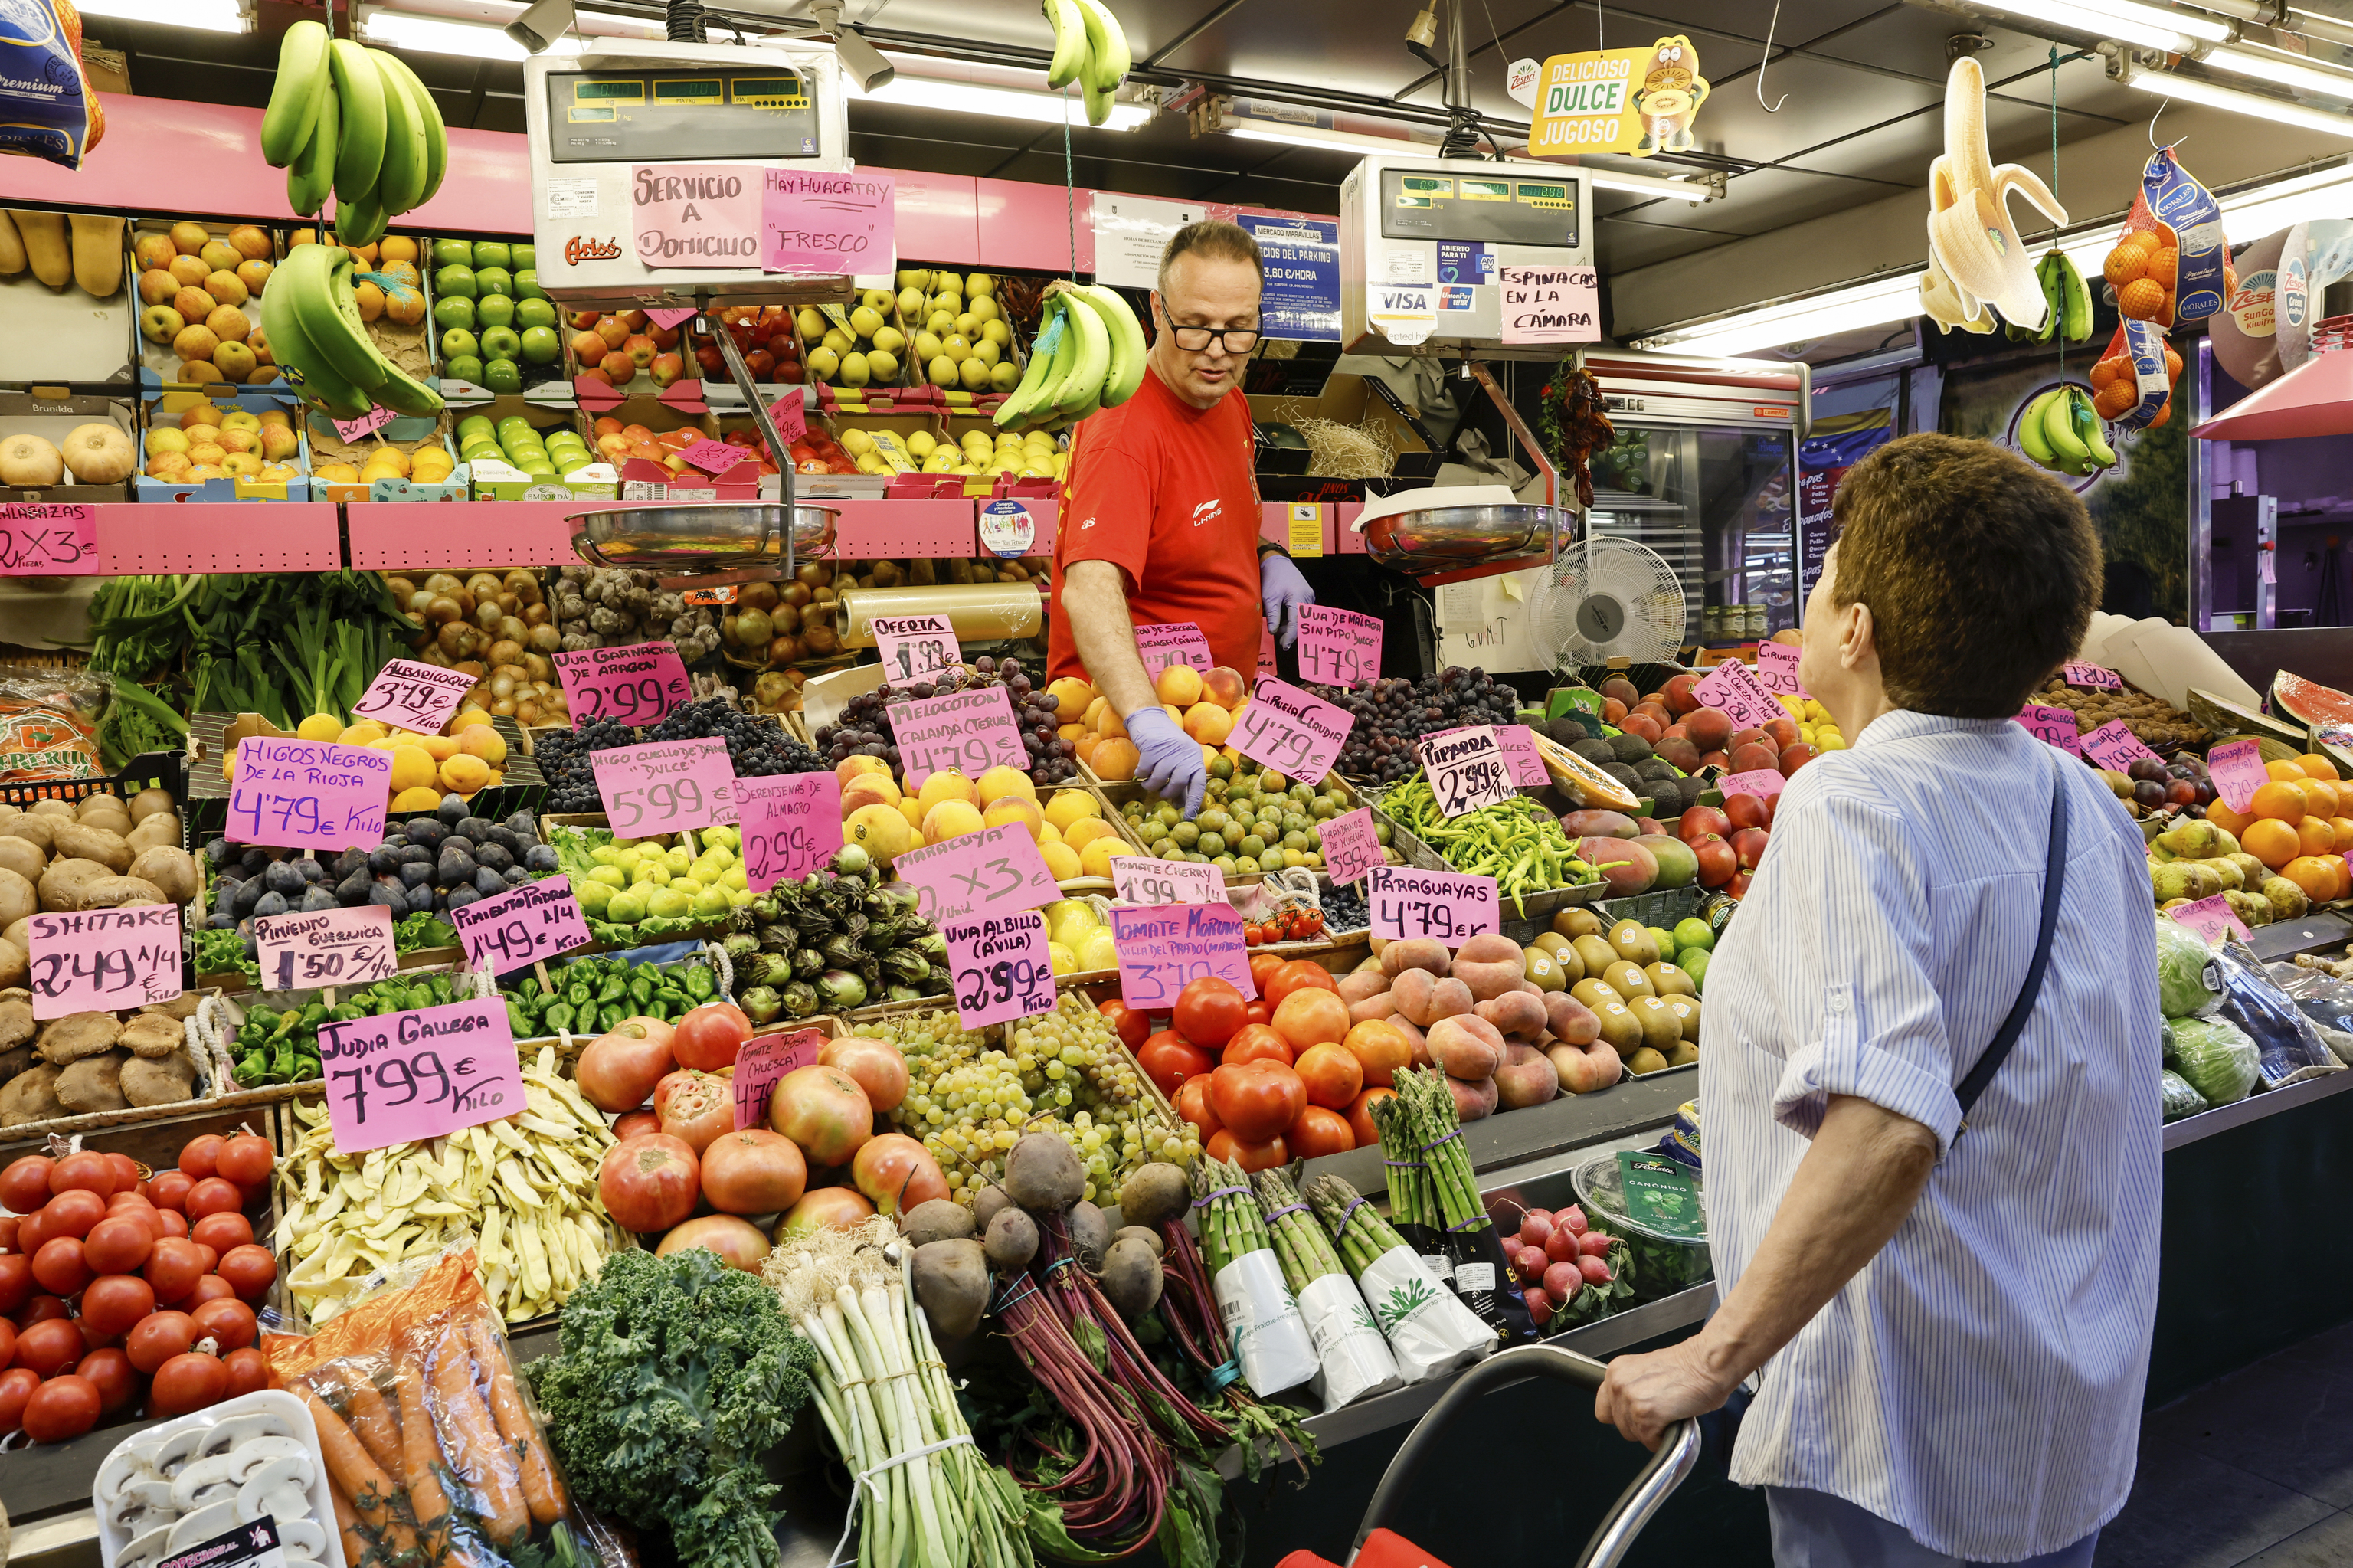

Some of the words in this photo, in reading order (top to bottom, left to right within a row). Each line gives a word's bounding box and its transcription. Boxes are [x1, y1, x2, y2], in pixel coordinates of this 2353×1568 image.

[1510, 71, 1536, 90] Zespri
[1551, 58, 1631, 83] DELICIOSO
[1548, 83, 1620, 113] DULCE
[1539, 119, 1619, 146] JUGOSO
[634, 169, 743, 207] SERVICIO
[799, 178, 890, 204] HUACATAY
[2159, 186, 2193, 214] MORALES
[682, 203, 702, 223] A
[638, 229, 758, 259] DOMICILIO
[1258, 228, 1285, 237] MERCADO
[1285, 230, 1320, 240] MARAVILLAS
[1259, 247, 1280, 259] ECIOS
[1282, 248, 1298, 260] DEL
[1299, 250, 1331, 264] PARKING
[1264, 267, 1283, 280] 3,60
[1284, 268, 1317, 281] €/HORA
[1500, 267, 1599, 289] ESPINACAS
[2184, 267, 2217, 279] Premium
[2285, 273, 2306, 293] Zespri
[1379, 293, 1427, 309] VISA
[1442, 292, 1471, 300] UnionPay
[1506, 291, 1527, 303] EN
[1534, 290, 1559, 302] LA
[2183, 299, 2218, 311] MORALES
[2289, 296, 2302, 307] Green
[1514, 309, 1592, 329] CÁMARA
[2244, 308, 2274, 321] SunGo
[32, 403, 74, 414] Brunilda
[784, 399, 800, 414] GALA
[1081, 517, 1096, 530] as
[1193, 507, 1222, 527] LI-NING
[875, 617, 945, 635] OFERTA
[1150, 626, 1163, 636] DE
[1165, 625, 1199, 633] SECANO
[1301, 624, 1324, 636] SIN
[1326, 627, 1350, 640] PIPO
[1332, 611, 1347, 627] DE
[1348, 614, 1382, 633] MÁLAGA
[592, 646, 677, 665] GARNACHA
[1304, 643, 1361, 683] 4'79
[569, 668, 591, 686] DE
[598, 662, 658, 676] ARAGON
[1719, 667, 1731, 679] DE
[358, 682, 437, 712] 3'79
[890, 690, 1000, 725] MELOCOTON
[1255, 679, 1298, 717] CIRUELA
[1296, 705, 1343, 743] CLAUDIA
[2035, 708, 2076, 725] GALLEGO
[900, 723, 963, 746] CALANDA
[1245, 709, 1314, 768] 4'79
[242, 740, 316, 766] HIGOS
[320, 748, 389, 773] NEGROS
[592, 753, 630, 768] HIGO
[911, 738, 993, 777] 4'79
[2219, 758, 2253, 777] (VALENCIA)
[244, 764, 267, 784] DE
[271, 768, 296, 784] LA
[304, 768, 365, 788] RIOJA
[1439, 761, 1491, 813] 2'99
[1720, 773, 1768, 790] NECTARINAS
[1740, 780, 1766, 791] EXTRA
[613, 777, 704, 828] 5'99
[735, 780, 807, 804] BERENJENAS
[809, 780, 823, 795] DE
[2219, 780, 2254, 810] 2'79
[233, 788, 320, 836] 4'79
[767, 802, 810, 820] ALMAGRO
[1320, 818, 1364, 840] ARÁNDANOS
[749, 825, 805, 879] 2'99
[898, 824, 1010, 869] MARACUYÁ
[1329, 840, 1340, 853] DE
[1340, 830, 1365, 849] HUELVA
[1110, 856, 1161, 874] TOMATE
[1165, 864, 1211, 882] CHERRY
[1330, 847, 1363, 879] 3'99
[1120, 876, 1177, 904] 1'99
[1370, 869, 1488, 902] PARAGUAYAS
[453, 898, 525, 930] PIMIENTO
[1381, 899, 1453, 938] 4'79
[2174, 902, 2206, 918] CIRUELA
[2205, 896, 2227, 908] PASA
[33, 907, 178, 940] SHITAKE
[255, 915, 330, 943] PIMIENTO
[945, 926, 980, 943] UVA
[983, 915, 1042, 937] ALBILLO
[1111, 909, 1180, 940] TOMATE
[1186, 908, 1242, 938] MORUNO
[470, 919, 535, 966] 1'49
[973, 932, 1031, 959] (ÁVILA)
[1119, 944, 1147, 956] VILLA
[1149, 944, 1167, 958] DEL
[1168, 941, 1203, 956] PRADO
[31, 948, 136, 999] 2'49
[270, 949, 345, 991] 1'50
[957, 959, 1036, 1012] 2'99
[319, 1023, 390, 1062] JUDIA
[398, 1014, 489, 1046] GALLEGA
[741, 1043, 774, 1063] TOMATE
[781, 1033, 810, 1053] ROSA
[747, 1051, 800, 1079] (HUESCA)
[331, 1050, 450, 1124] 7'99
[1634, 1161, 1675, 1175] Florette
[1628, 1180, 1687, 1192] CANÓNIGO
